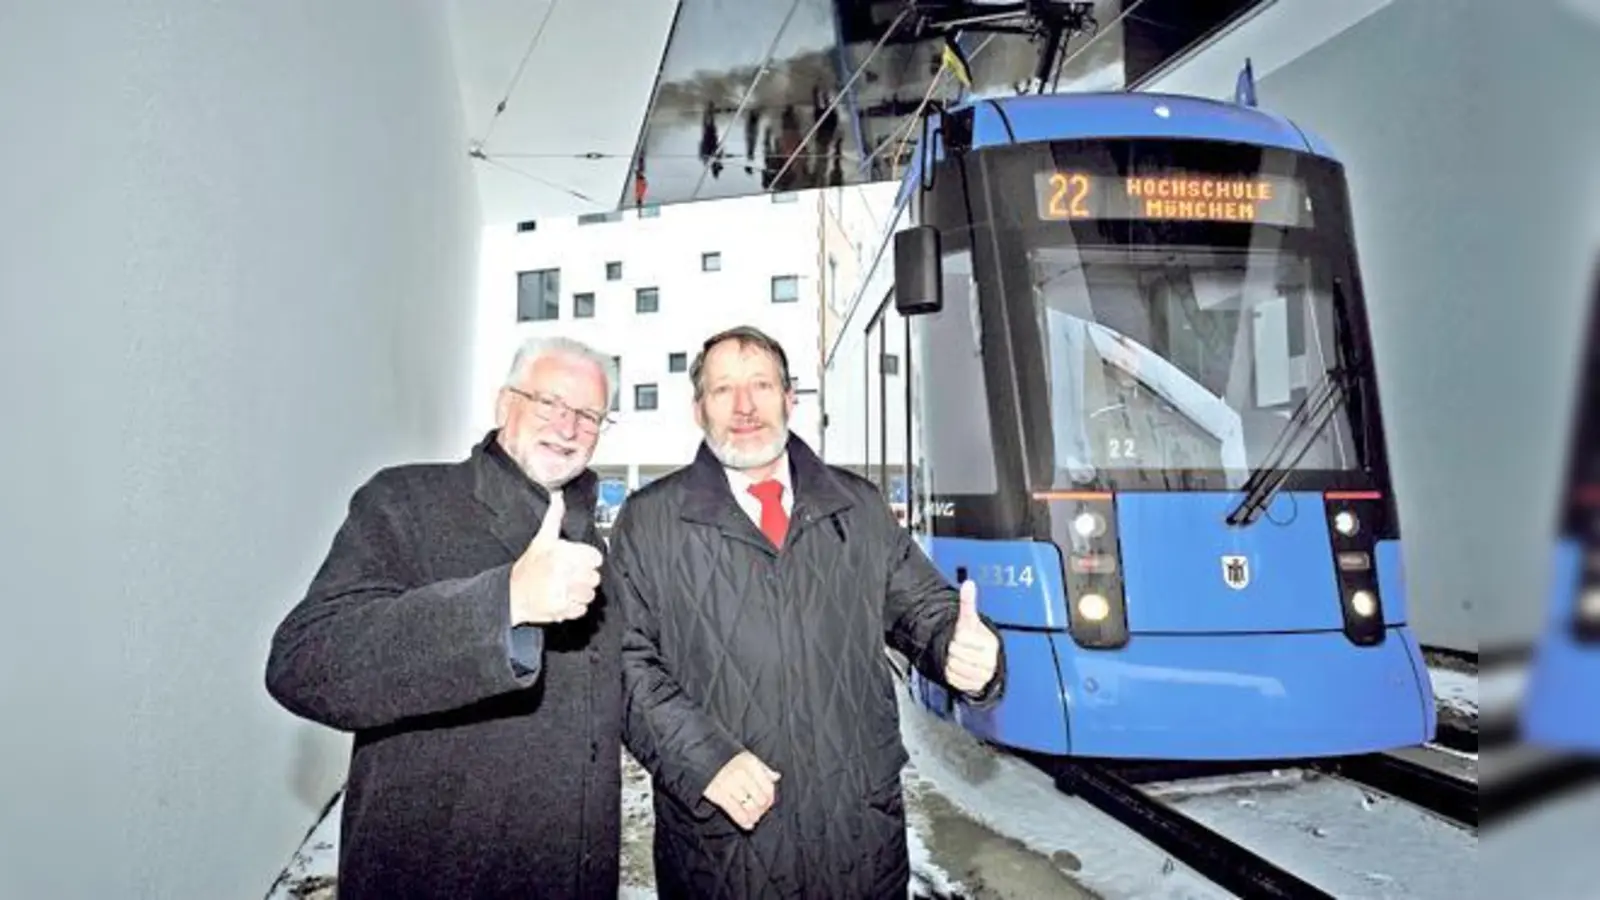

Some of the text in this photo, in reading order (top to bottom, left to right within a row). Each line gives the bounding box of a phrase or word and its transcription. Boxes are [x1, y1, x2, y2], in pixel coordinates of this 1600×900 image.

[1048, 173, 1090, 217] 22
[1126, 178, 1273, 200] HOCHSCHULE
[1109, 438, 1137, 459] 22
